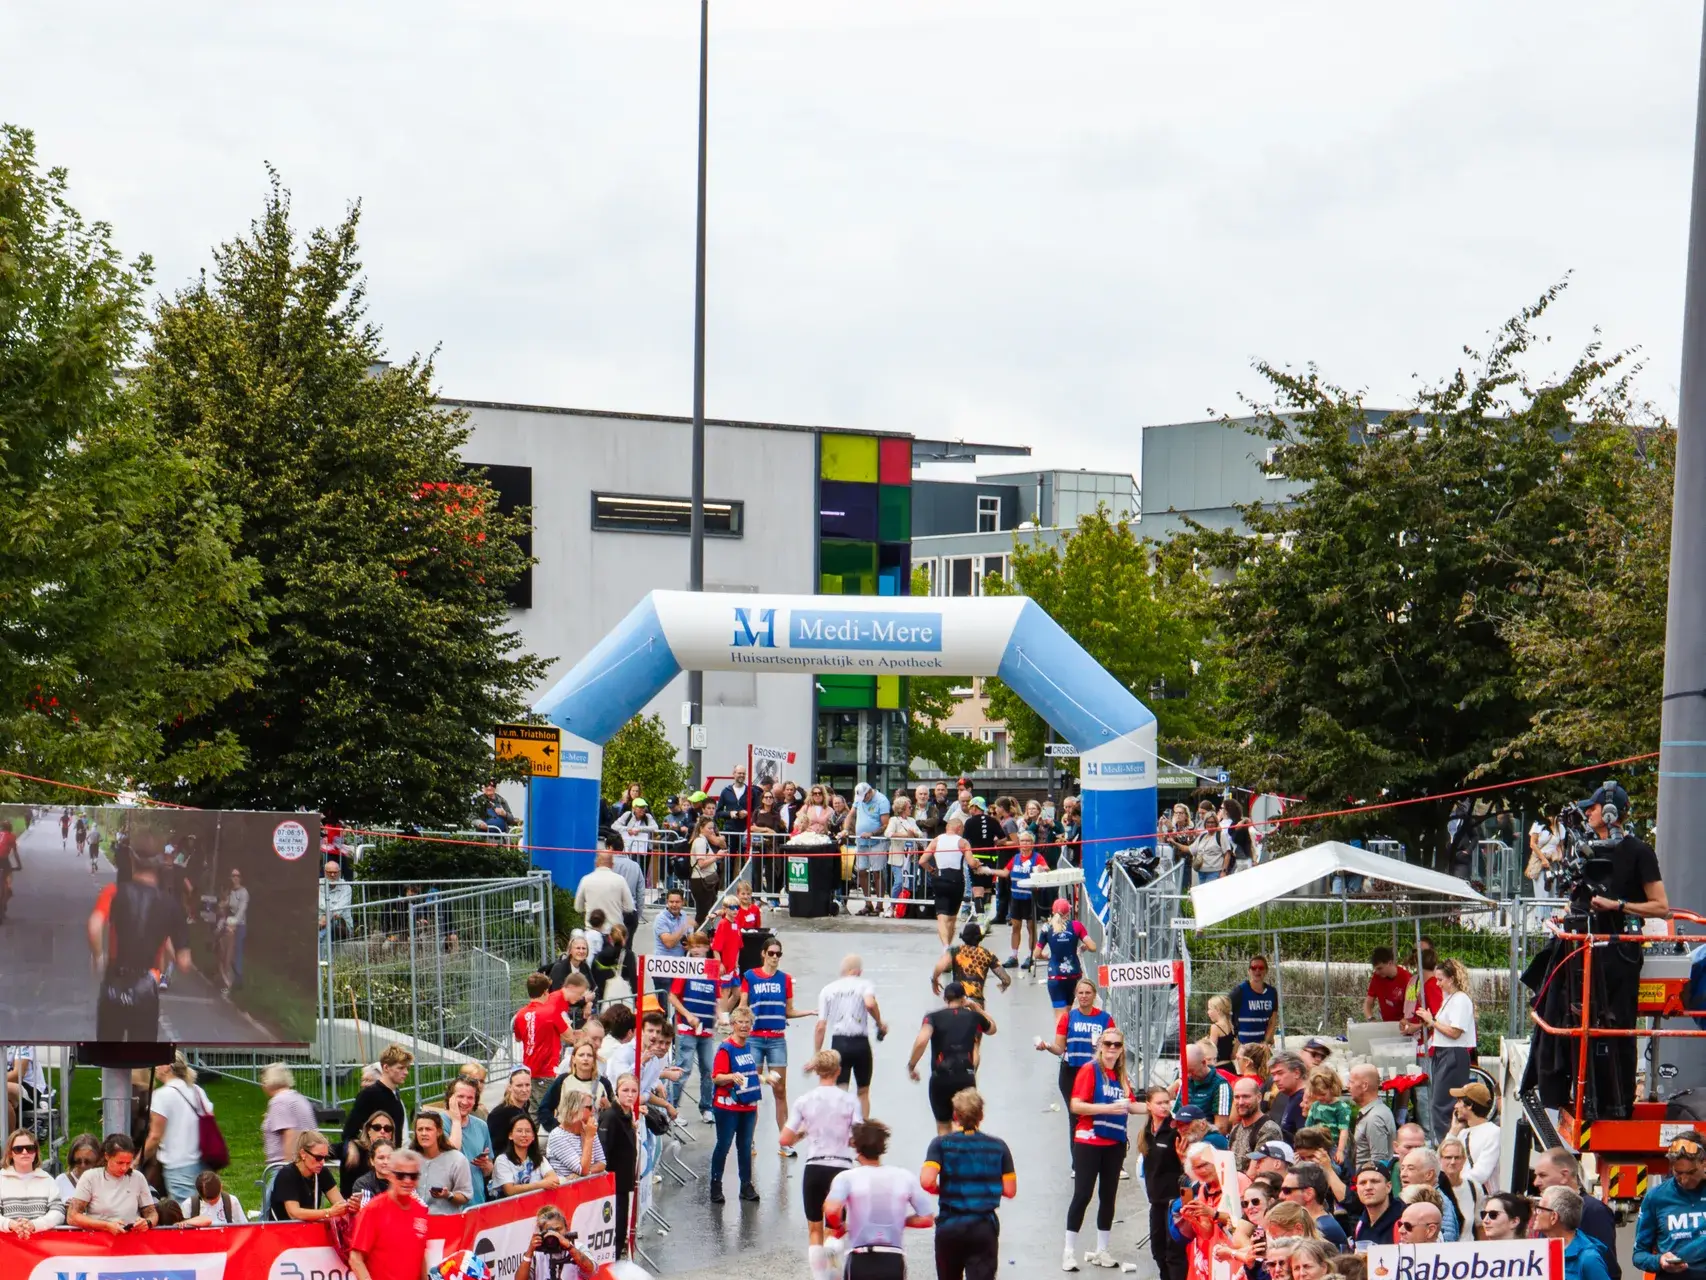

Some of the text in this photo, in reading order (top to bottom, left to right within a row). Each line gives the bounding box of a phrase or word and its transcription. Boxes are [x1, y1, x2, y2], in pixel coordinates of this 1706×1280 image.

[798, 618, 933, 643] Medi-Mere
[731, 652, 854, 668] Huisartsenpraktijk
[878, 657, 942, 669] Apotheek
[520, 729, 556, 740] Triathlon
[753, 747, 787, 760] CROSSING
[1104, 764, 1144, 774] Medi-Mere
[647, 958, 705, 975] CROSSING
[1110, 964, 1171, 983] CROSSING
[753, 982, 782, 995] WATER
[1247, 1000, 1273, 1011] WATER
[1074, 1021, 1103, 1034] WATER
[1102, 1084, 1125, 1098] WATE
